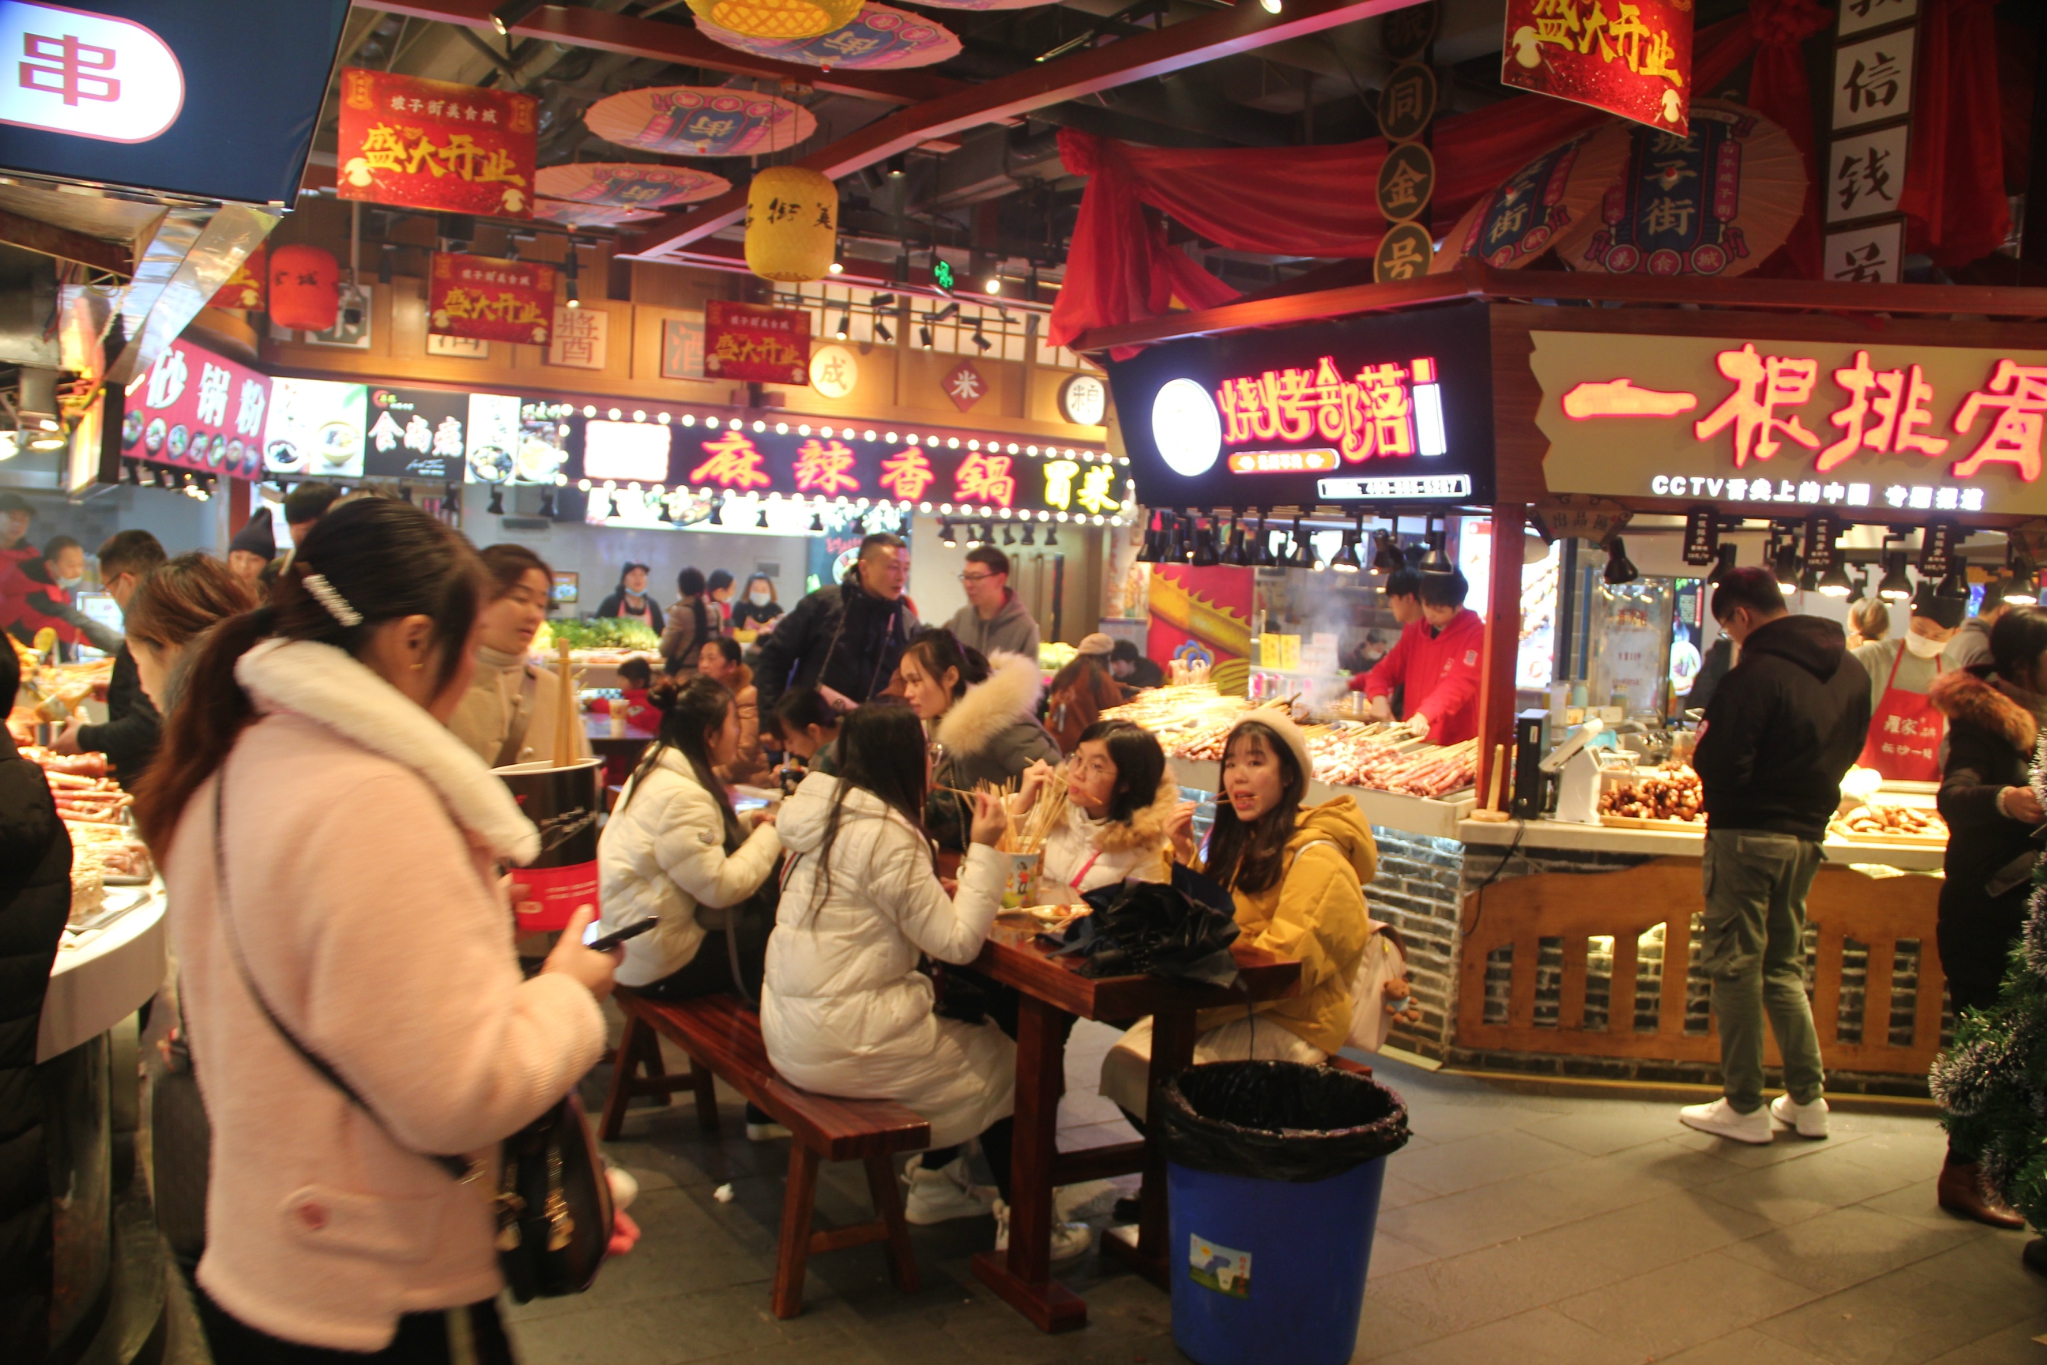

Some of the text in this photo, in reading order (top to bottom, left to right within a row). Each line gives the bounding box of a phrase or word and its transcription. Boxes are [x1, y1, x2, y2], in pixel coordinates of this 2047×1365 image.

[19, 32, 120, 107] 串
[1531, 0, 1683, 87] 盛大开业
[361, 122, 526, 187] 盛大开业
[1834, 0, 1901, 282] 信钱号
[443, 286, 548, 327] 盛大开业
[714, 331, 806, 368] 盛大开业
[819, 355, 847, 391] 成
[950, 369, 980, 399] 米
[1215, 355, 1416, 463] 烧烤部落
[1563, 342, 2047, 483] 一根排骨
